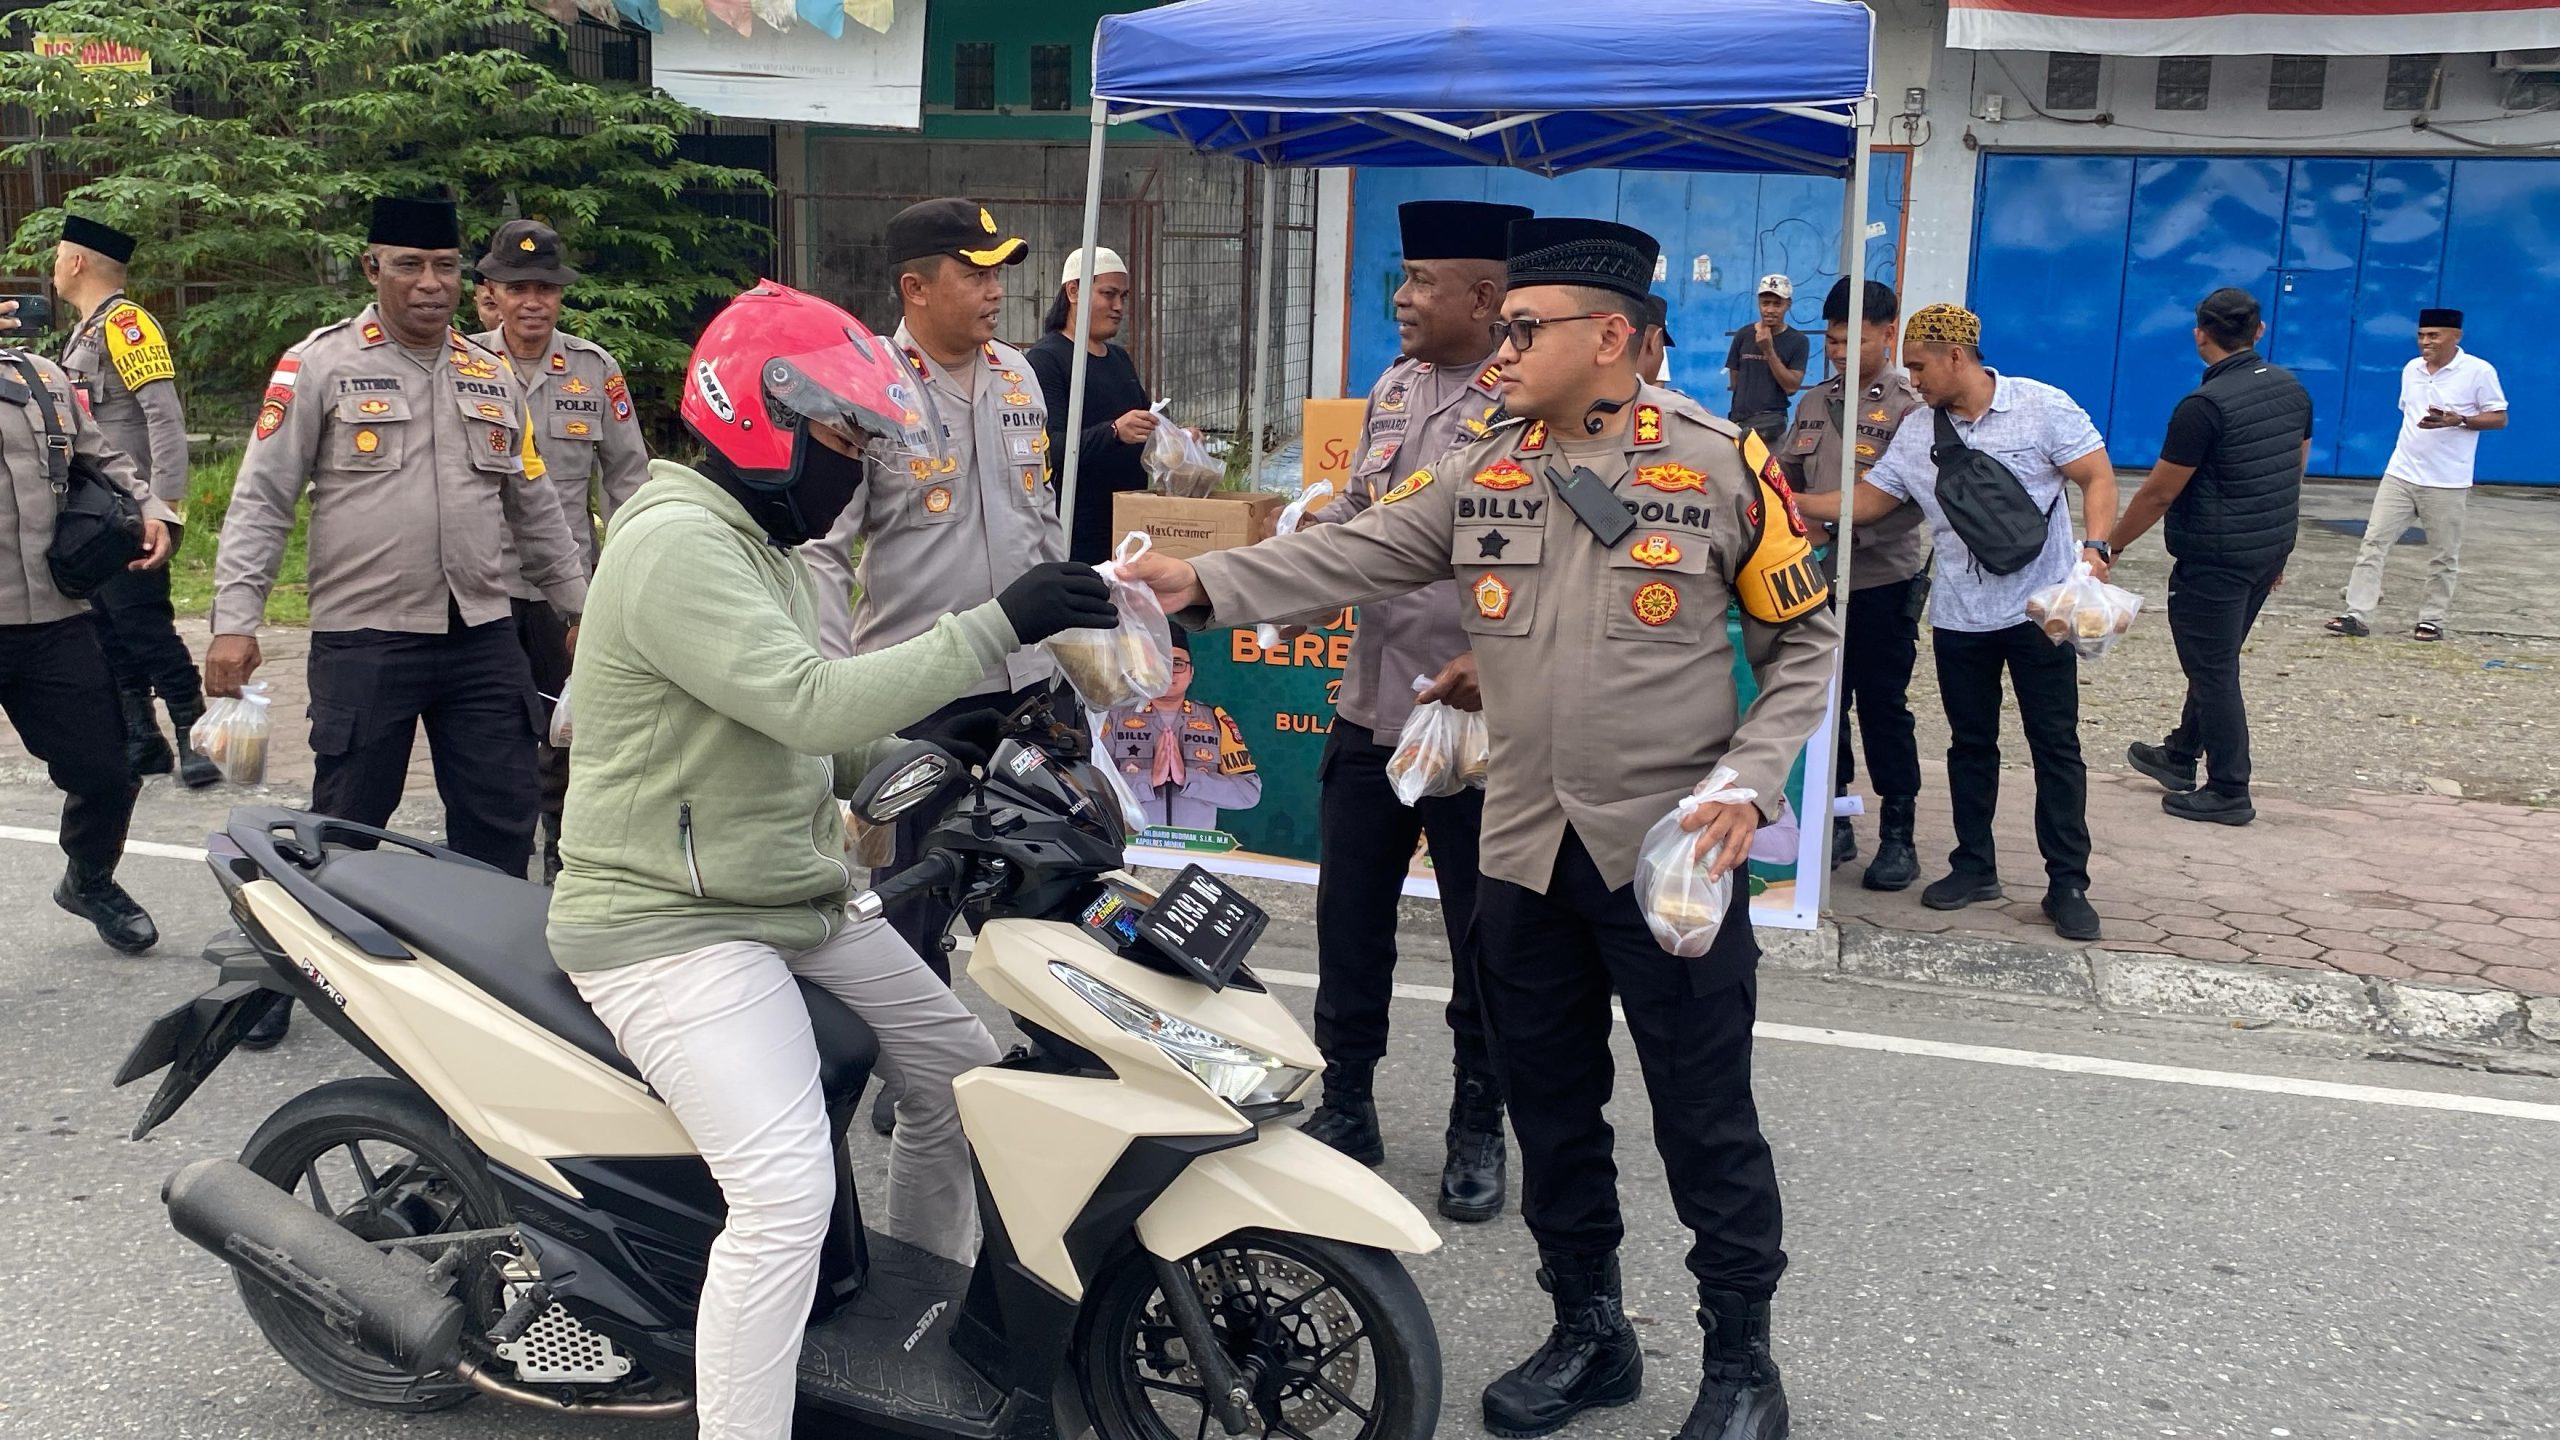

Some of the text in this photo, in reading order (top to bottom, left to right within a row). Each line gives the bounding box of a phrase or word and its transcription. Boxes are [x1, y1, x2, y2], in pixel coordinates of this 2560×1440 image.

[44, 40, 143, 65] DISWAKAN
[116, 345, 170, 374] KAPOLSEK
[456, 381, 508, 398] POLRI
[700, 366, 732, 413] INK
[556, 400, 598, 412] POLRI
[1458, 497, 1543, 519] BILLY
[1622, 501, 1711, 529] POLRI
[1146, 524, 1212, 540] MaxCreamer
[1117, 732, 1152, 741] BILLY
[1184, 733, 1218, 746] POLRI
[1084, 892, 1112, 922] SPEED
